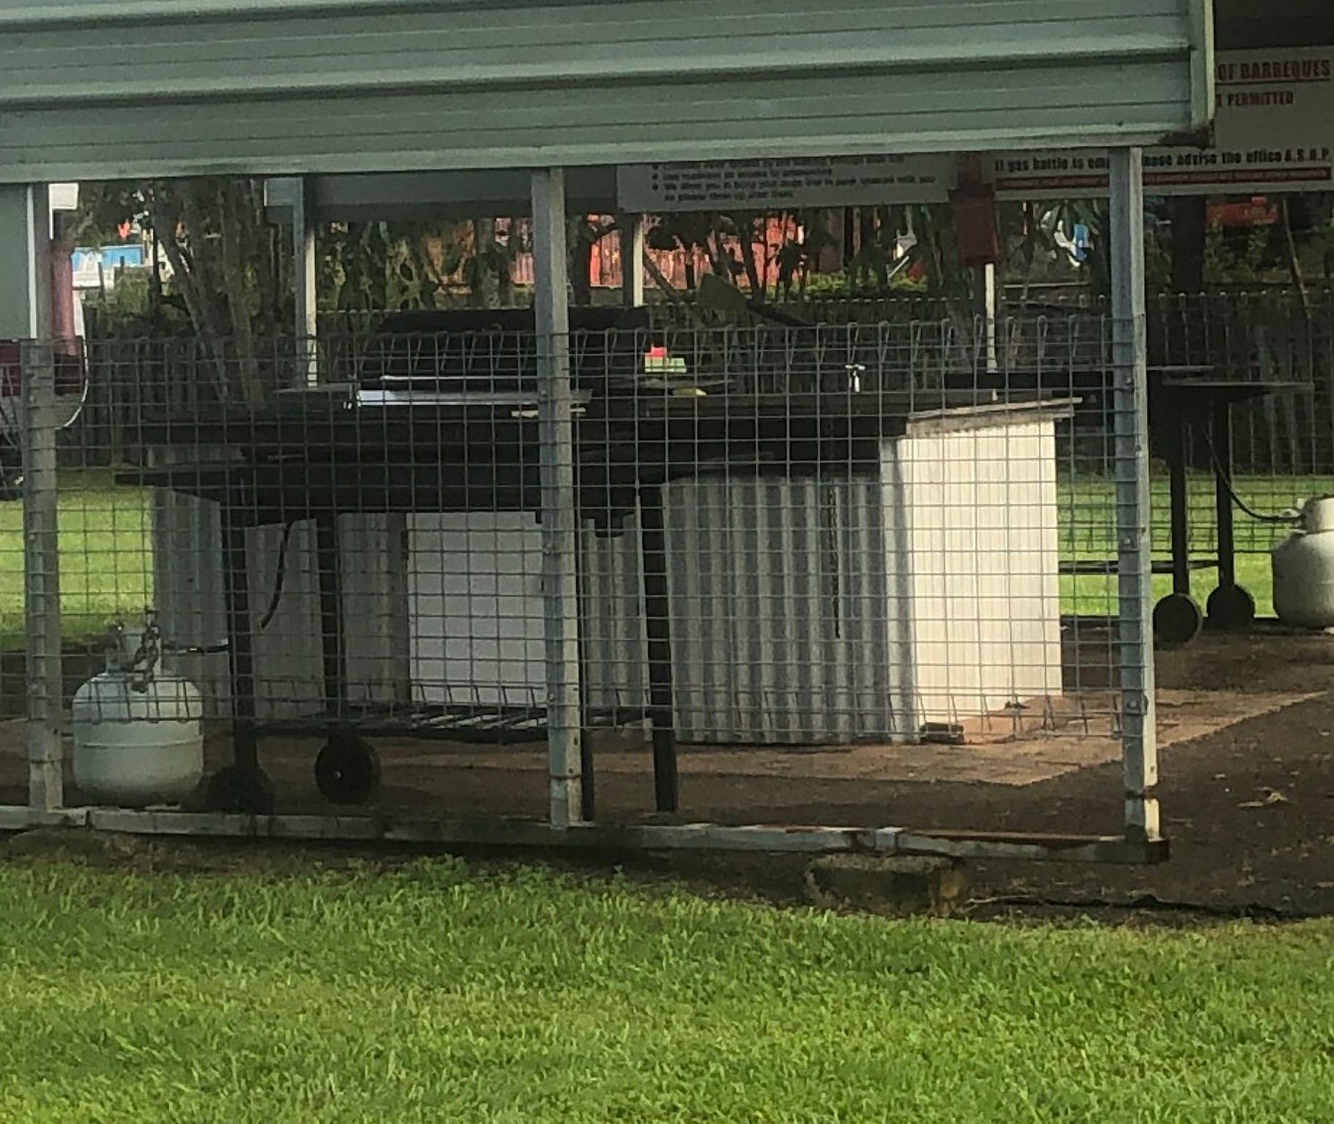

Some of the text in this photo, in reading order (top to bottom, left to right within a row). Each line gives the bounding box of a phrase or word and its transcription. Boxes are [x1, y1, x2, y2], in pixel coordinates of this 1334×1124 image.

[1217, 59, 1331, 81] OF BARBEQUES
[1228, 91, 1294, 107] PERMITTED
